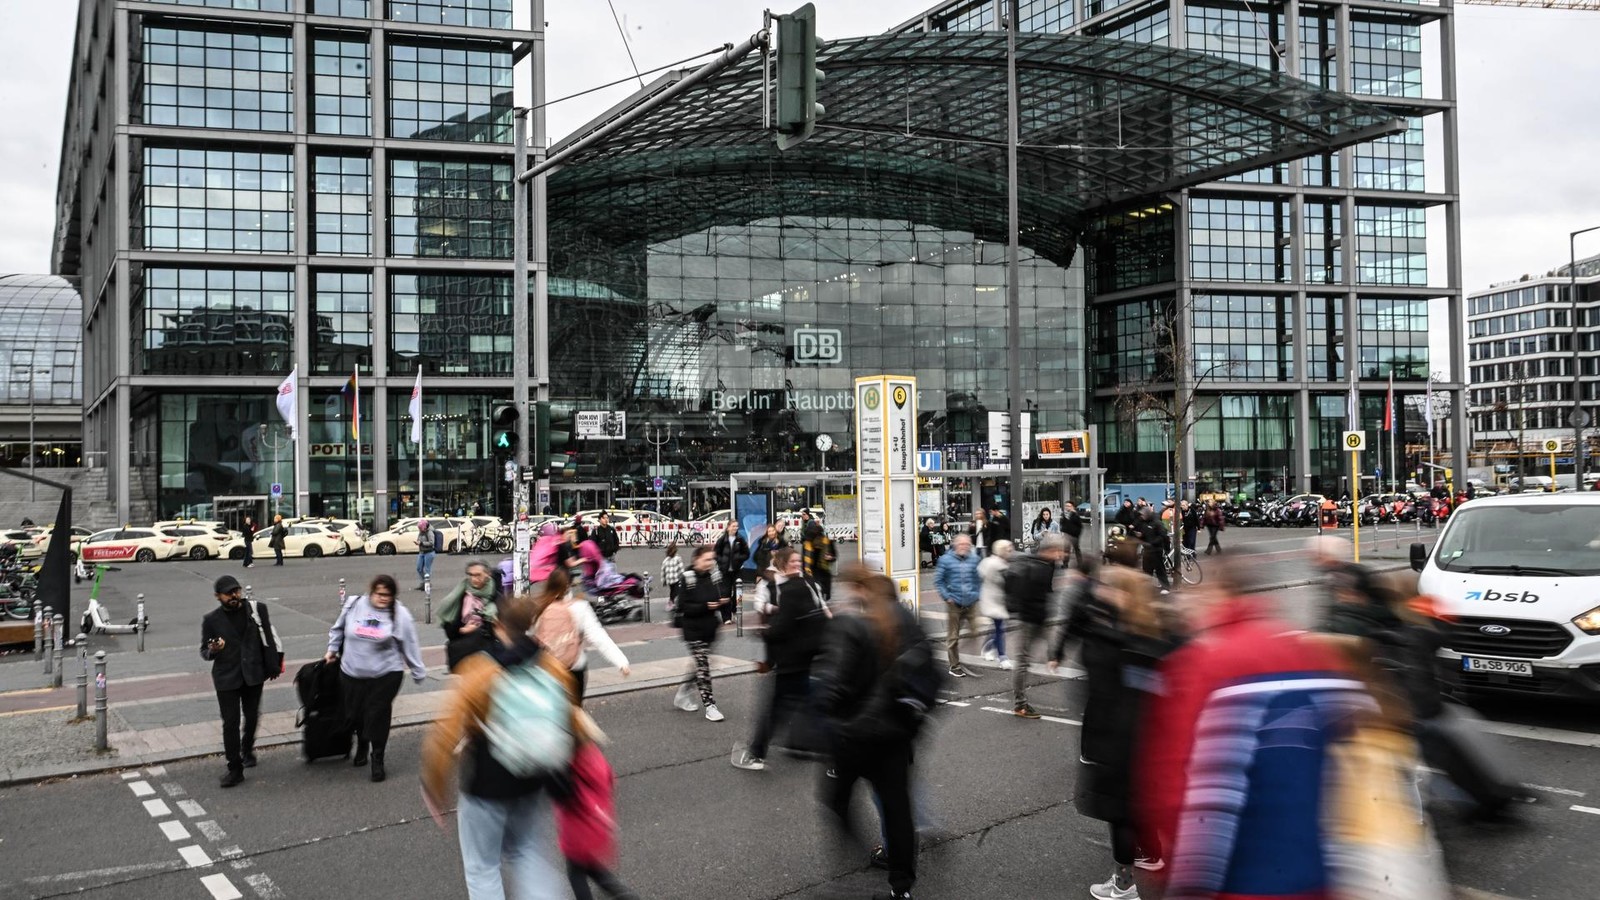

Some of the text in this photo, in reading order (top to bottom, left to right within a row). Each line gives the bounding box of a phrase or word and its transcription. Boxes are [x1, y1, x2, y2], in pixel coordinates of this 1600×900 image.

[800, 334, 836, 358] DB
[711, 390, 770, 410] Berlin
[897, 390, 902, 400] 6
[917, 452, 931, 471] U
[1483, 589, 1540, 604] bsb
[1473, 659, 1527, 672] B SB 906
